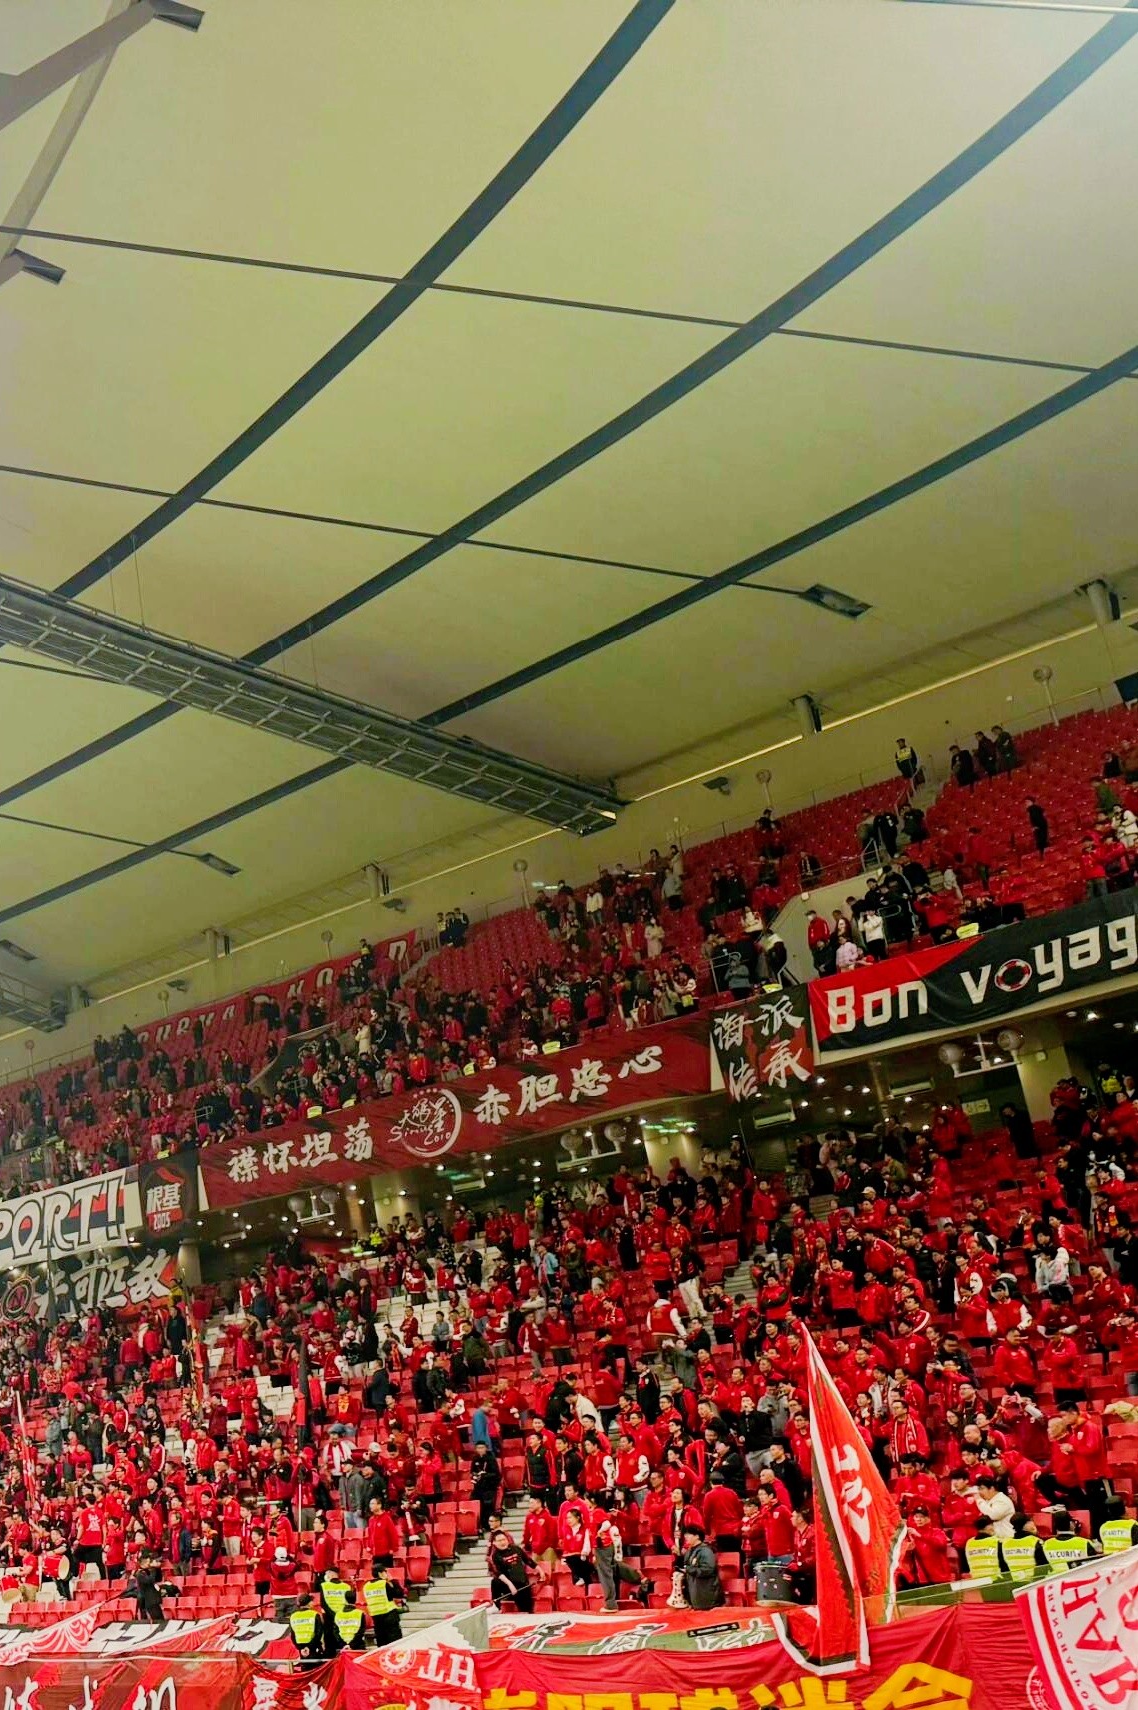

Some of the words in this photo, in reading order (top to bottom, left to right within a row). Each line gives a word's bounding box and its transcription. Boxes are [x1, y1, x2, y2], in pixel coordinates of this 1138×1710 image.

[825, 980, 928, 1034] Bon
[473, 1046, 663, 1126] 赤胆忠心
[227, 1117, 374, 1183] 襟怀坦荡
